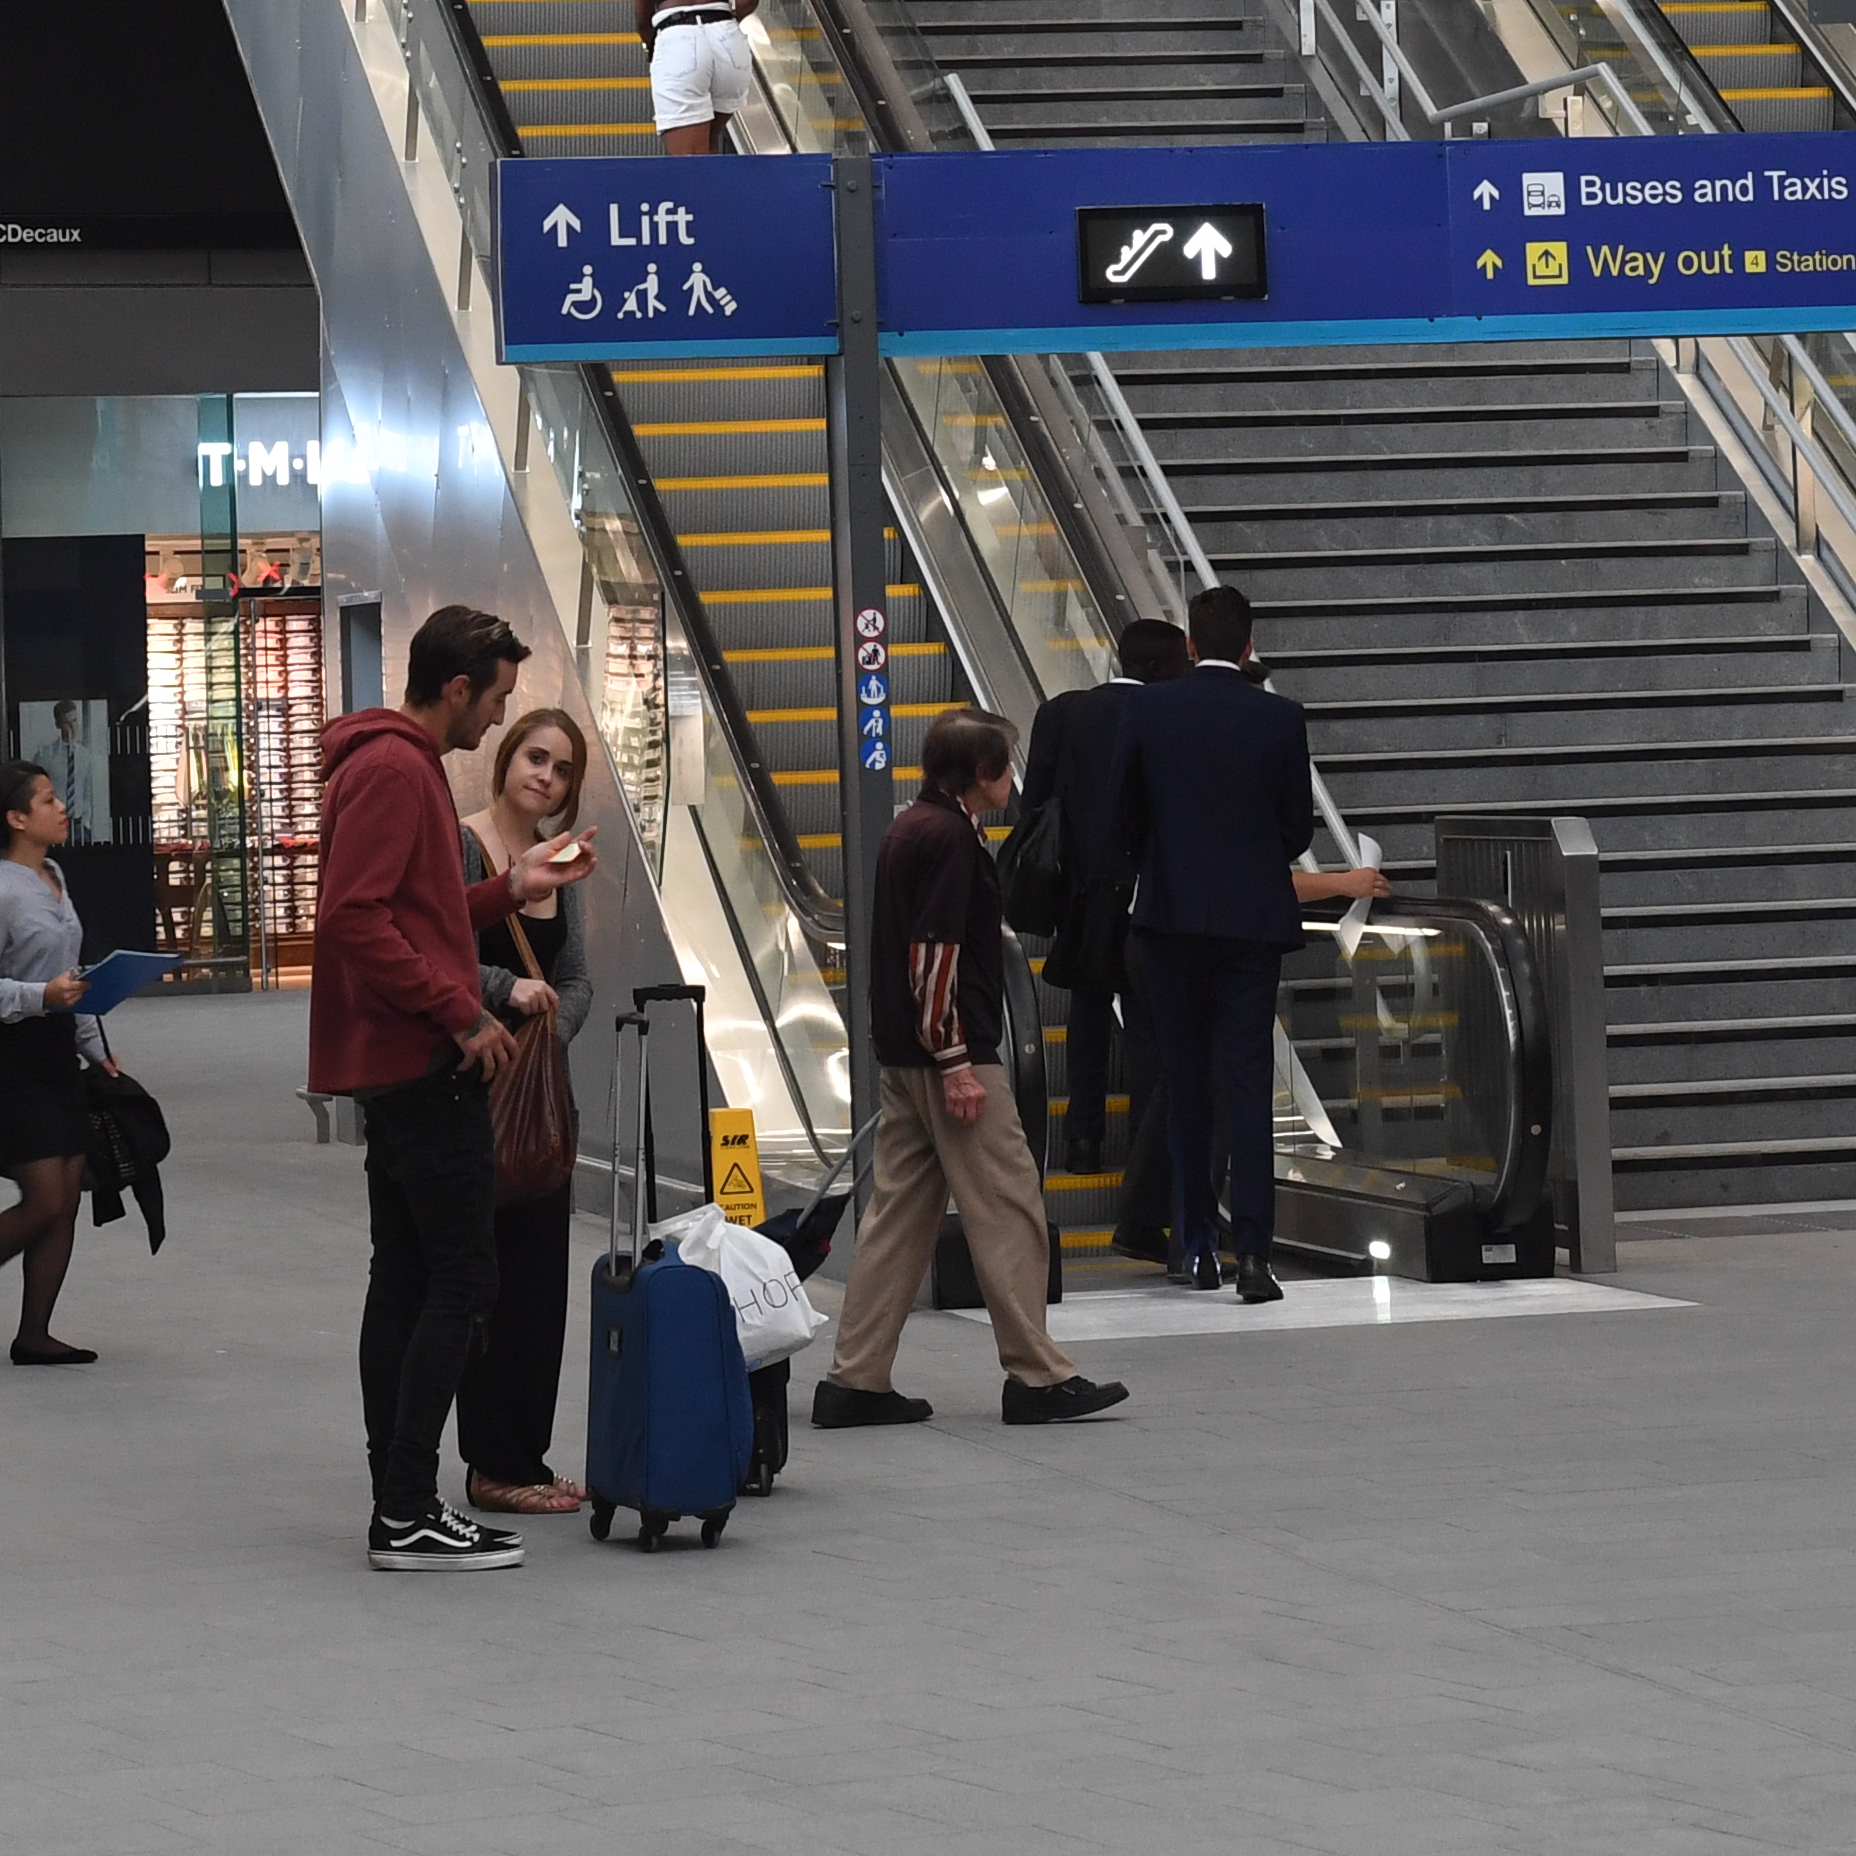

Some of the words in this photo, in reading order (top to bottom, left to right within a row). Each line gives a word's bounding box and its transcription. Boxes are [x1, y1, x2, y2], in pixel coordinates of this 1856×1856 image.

[1579, 175, 1683, 205] Buses
[1693, 171, 1754, 203] and
[1763, 169, 1849, 201] Taxis
[609, 201, 695, 246] Lift
[1586, 244, 1666, 284] Way
[1677, 243, 1734, 275] out
[1775, 250, 1856, 273] Station
[721, 1202, 758, 1211] AUTION
